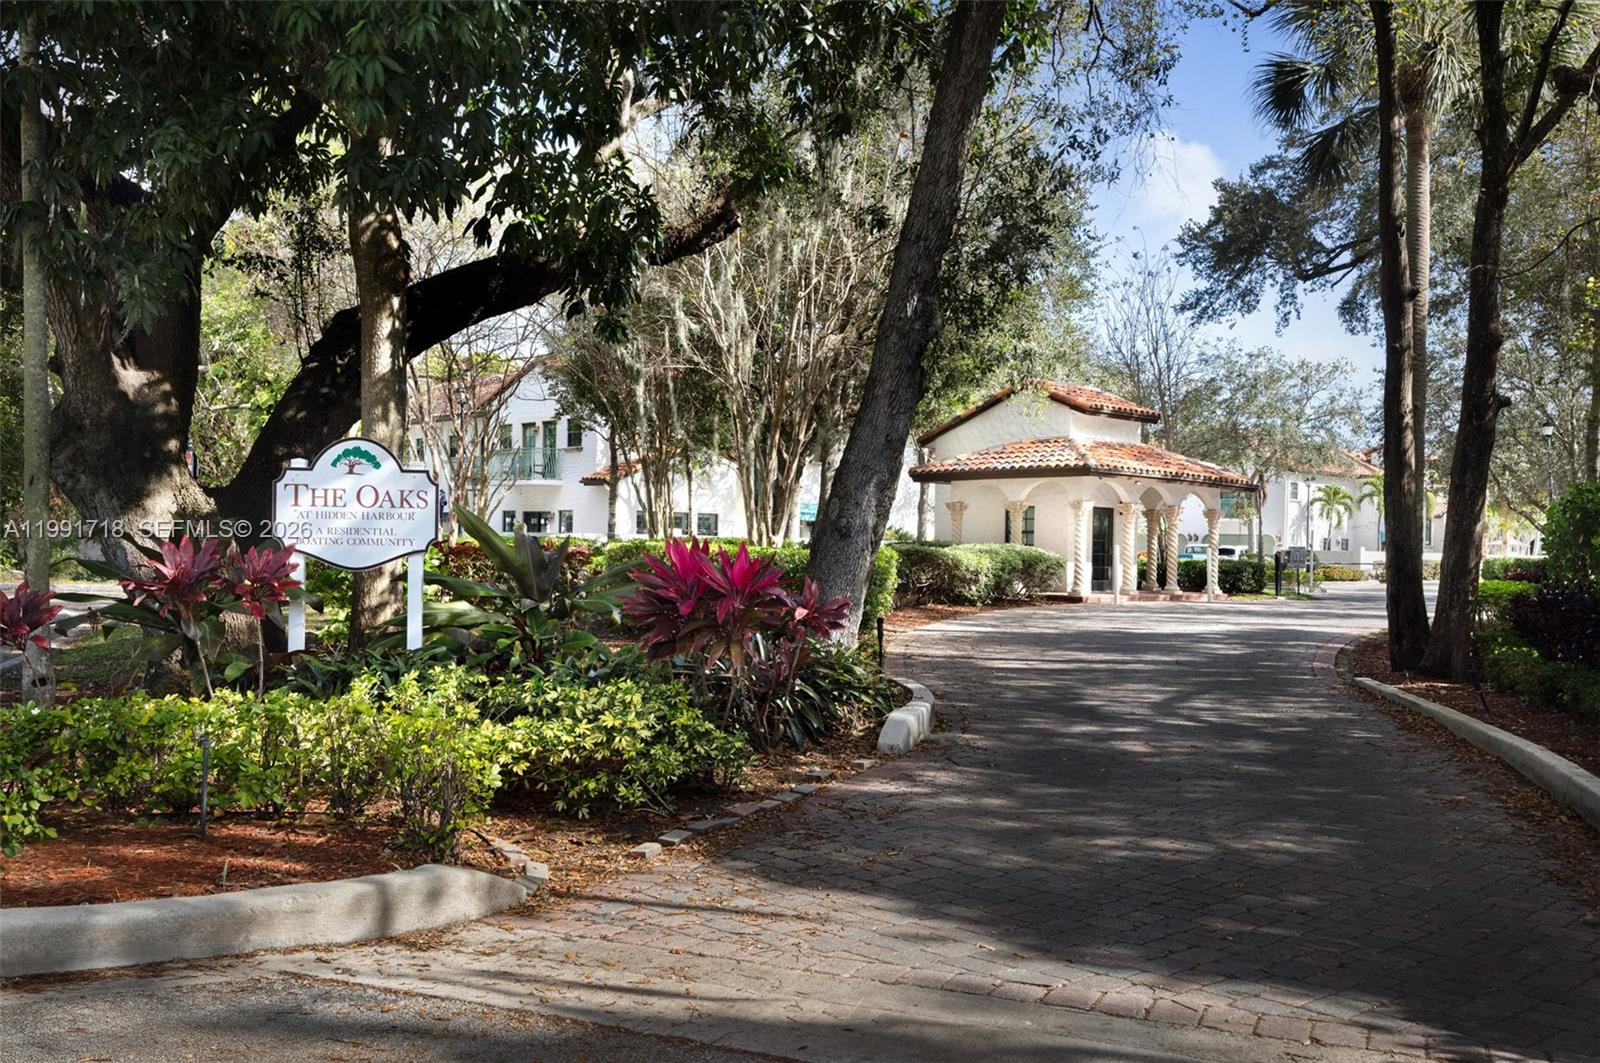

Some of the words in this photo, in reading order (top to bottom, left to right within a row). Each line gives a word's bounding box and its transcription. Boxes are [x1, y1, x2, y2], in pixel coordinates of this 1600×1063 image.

[297, 511, 312, 520] AT
[315, 511, 358, 520] HIDDEN
[362, 511, 416, 521] HARBOUR
[315, 527, 323, 535] A
[327, 527, 397, 536] RESIDENTIAL
[296, 537, 343, 546] BOATING
[346, 537, 416, 546] COMMUNITY
